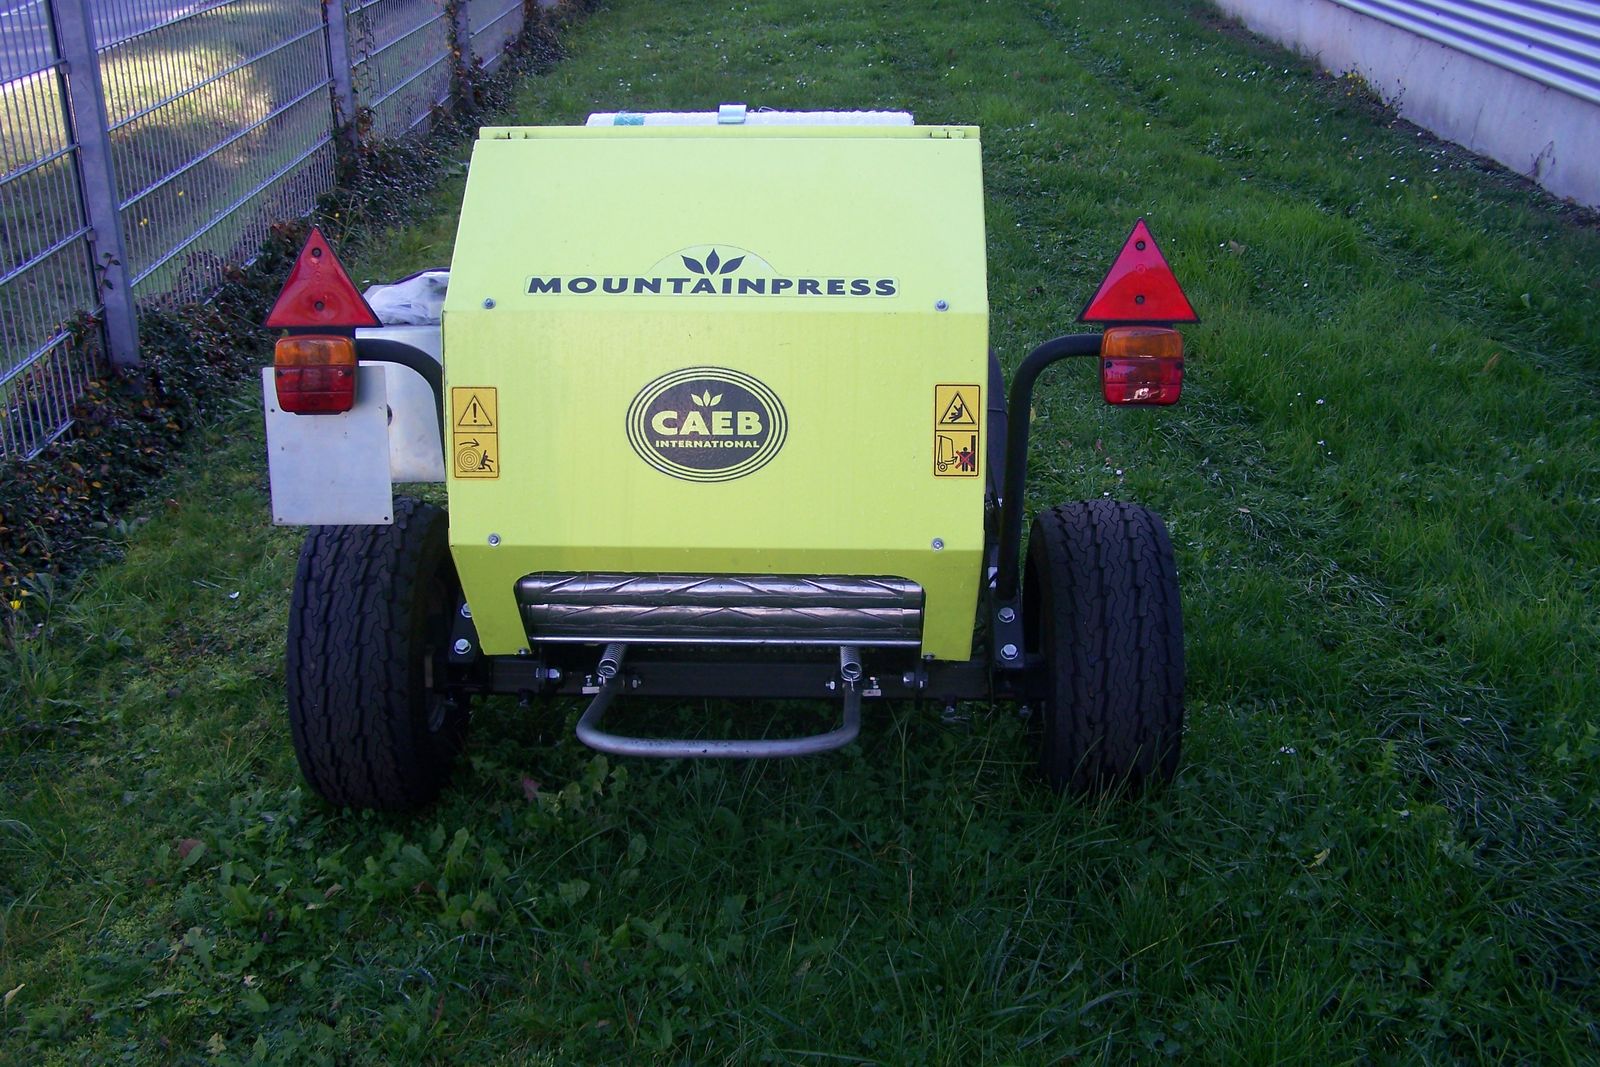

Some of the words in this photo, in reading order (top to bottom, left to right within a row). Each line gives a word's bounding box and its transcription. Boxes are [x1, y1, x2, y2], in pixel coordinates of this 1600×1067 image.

[527, 277, 897, 297] MOUNTAINPRESS
[651, 410, 763, 436] CAEB
[655, 440, 760, 449] INTERNATIONAL
